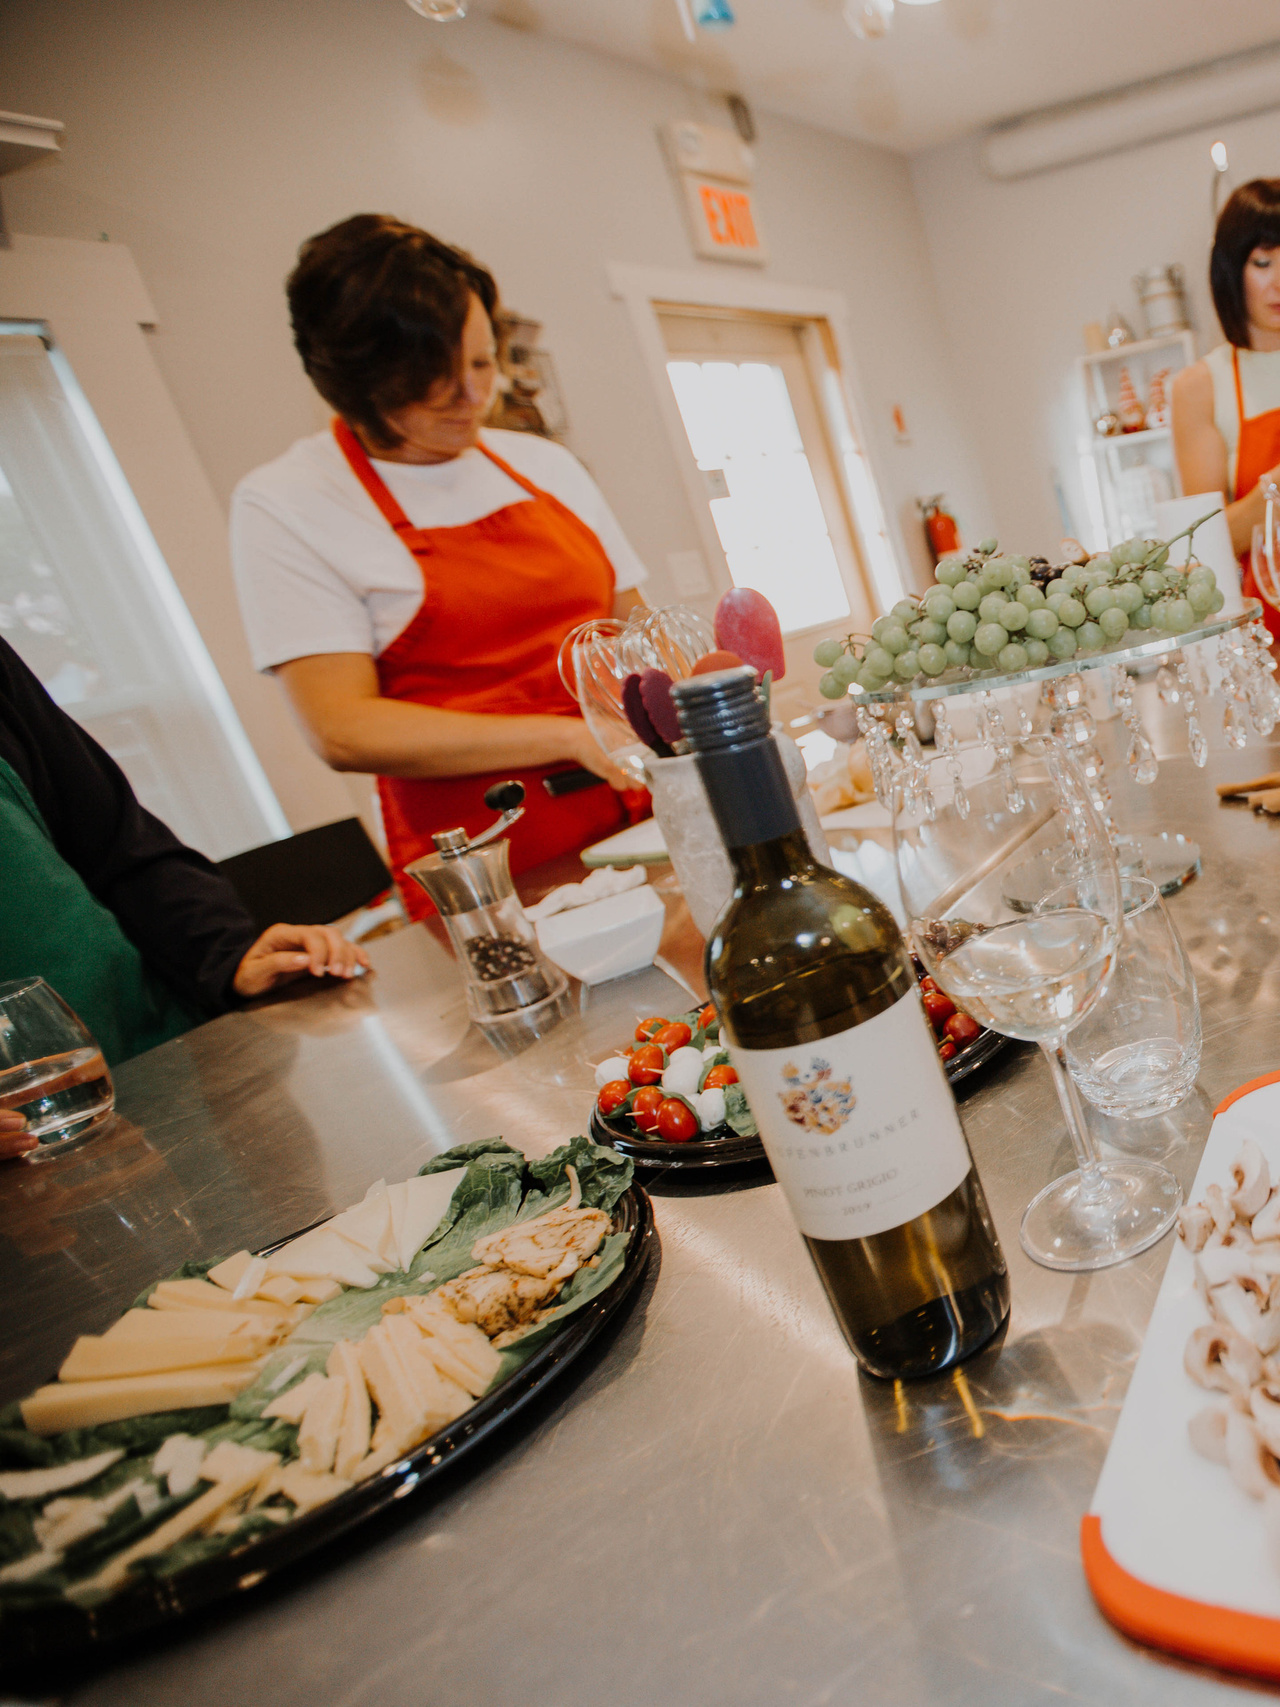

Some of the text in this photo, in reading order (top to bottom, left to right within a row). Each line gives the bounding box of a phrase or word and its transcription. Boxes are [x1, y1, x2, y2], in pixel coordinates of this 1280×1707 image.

[698, 184, 760, 249] EXIT
[803, 1168, 899, 1199] PINOT GRIGIO
